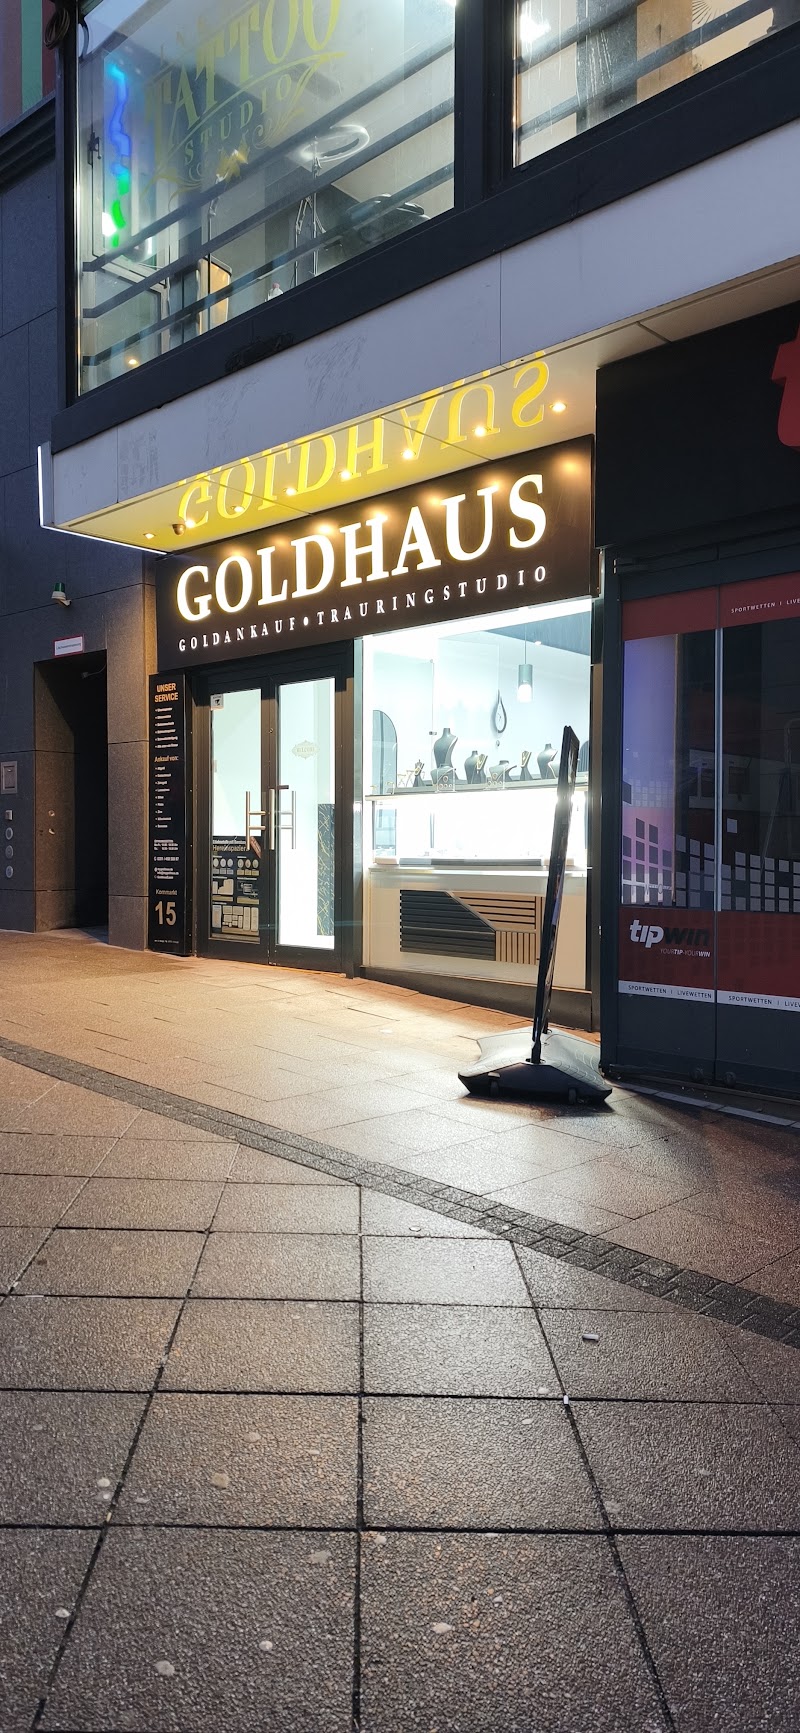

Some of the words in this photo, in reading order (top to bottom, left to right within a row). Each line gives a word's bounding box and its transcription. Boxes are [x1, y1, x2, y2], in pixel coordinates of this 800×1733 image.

[144, 0, 341, 166] TATTOO
[184, 73, 292, 166] STUDIO
[176, 474, 548, 622] GOLDHAUS
[178, 615, 296, 652] GOLDANKAUF
[317, 565, 547, 627] TRAURINGSTUDIO
[731, 602, 776, 614] SPORTWETTEN
[154, 692, 179, 703] SERVICE
[156, 683, 176, 693] UNSER
[155, 901, 177, 926] 15
[628, 984, 667, 995] SPORTWETTEN
[677, 989, 712, 999] LIVEWETTEN
[728, 995, 772, 1005] SPORTWETTEN
